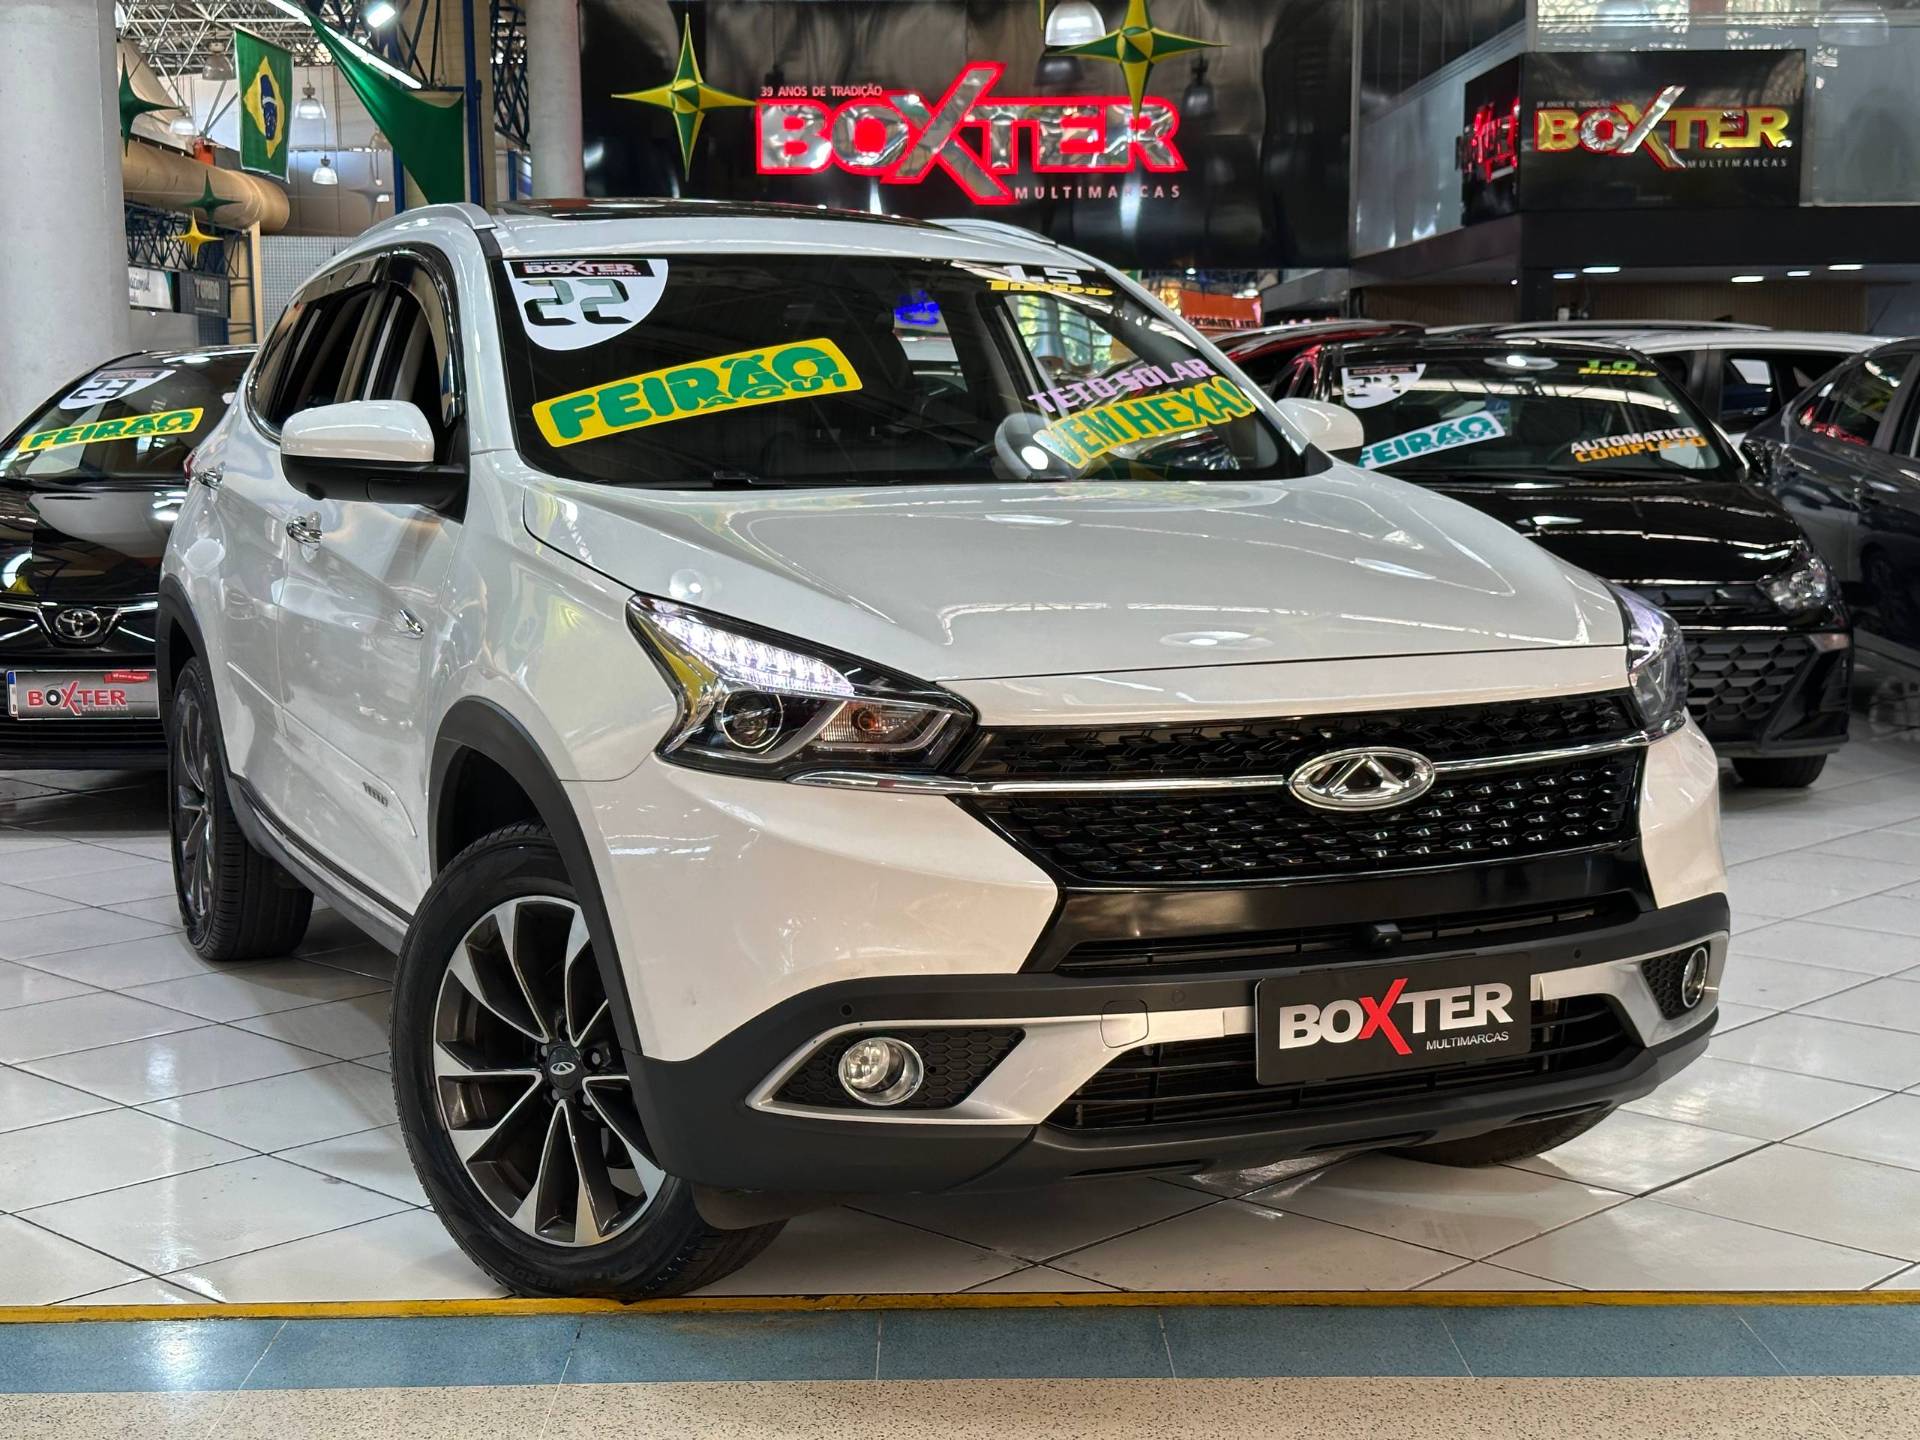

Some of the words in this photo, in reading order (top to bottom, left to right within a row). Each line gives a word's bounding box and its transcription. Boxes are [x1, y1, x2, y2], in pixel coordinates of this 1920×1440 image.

[761, 86, 773, 97] 39
[778, 86, 807, 97] ANOS
[812, 86, 826, 97] DE
[831, 83, 882, 98] TRADIÇÃO
[757, 62, 1188, 204] BOXTER
[1533, 85, 1794, 169] BOXTER
[1688, 159, 1788, 169] MULTIMARCAS
[1015, 186, 1180, 200] MULTIMARCAS
[522, 260, 637, 275] BOXTER
[521, 279, 633, 326] 22
[1587, 360, 1636, 370] 1.0
[69, 379, 136, 399] 23
[549, 347, 840, 439] FEIRÃO
[1028, 376, 1117, 412] TETO
[1116, 359, 1217, 391] SOLAR
[28, 412, 195, 449] FEIRÃO
[27, 680, 127, 716] BOXTER
[1279, 978, 1513, 1055] BOXTER
[1426, 1031, 1509, 1051] MULTIMARCAS
